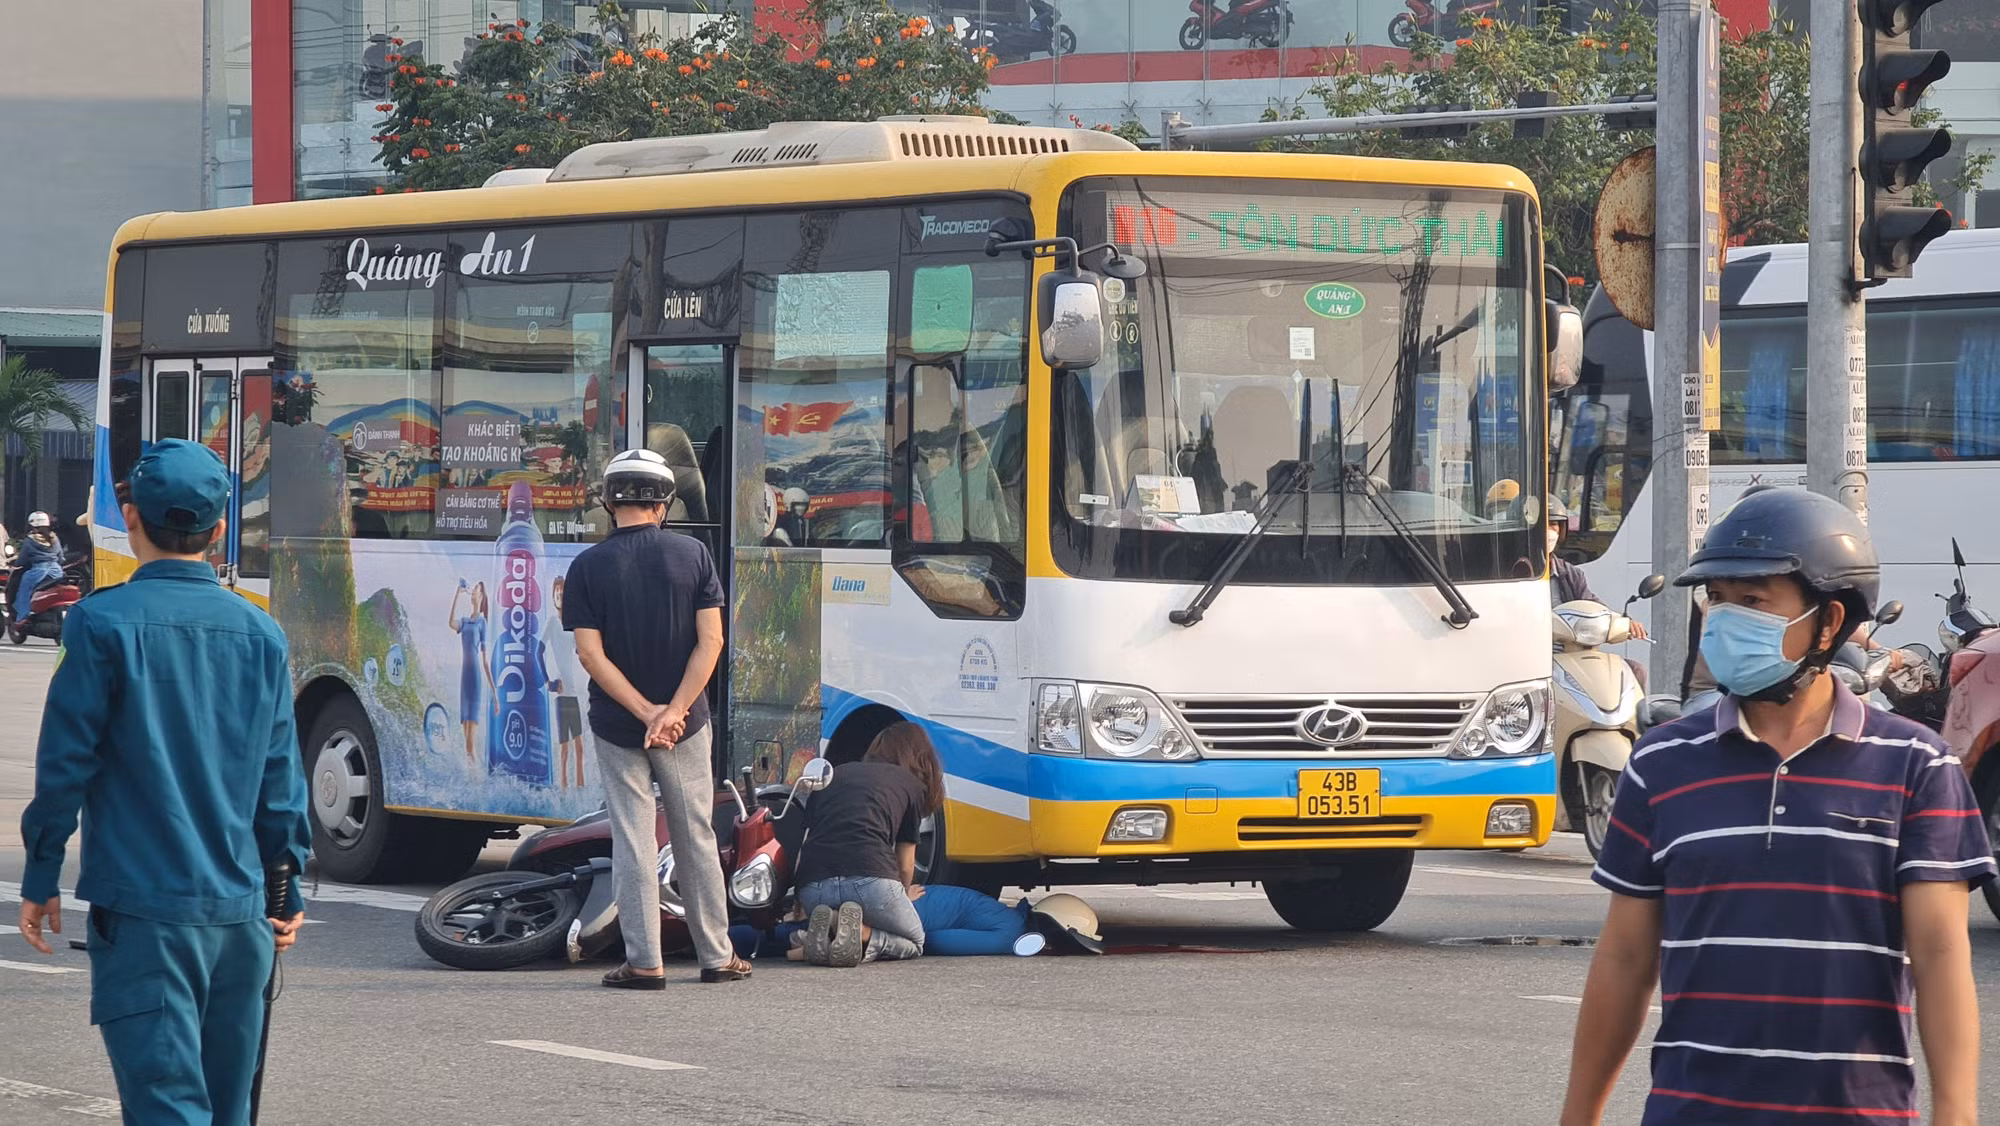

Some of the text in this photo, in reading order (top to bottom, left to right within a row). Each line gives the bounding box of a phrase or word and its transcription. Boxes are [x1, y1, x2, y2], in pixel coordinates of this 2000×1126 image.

[920, 215, 990, 242] TRACOMECO
[1208, 203, 1297, 252] TÔN
[1312, 207, 1403, 256] ĐỨC
[346, 231, 536, 291] Quảng An 1
[664, 290, 702, 319] CỬA LÊN
[187, 307, 230, 334] CỬA XUỐNG
[468, 420, 494, 437] KHÁC
[495, 420, 515, 440] BIỆT
[442, 446, 461, 465] TẠO
[463, 443, 508, 463] KHOÁNG
[509, 733, 523, 748] 9.0
[1322, 772, 1357, 792] 43B
[1308, 795, 1369, 815] 053.51
